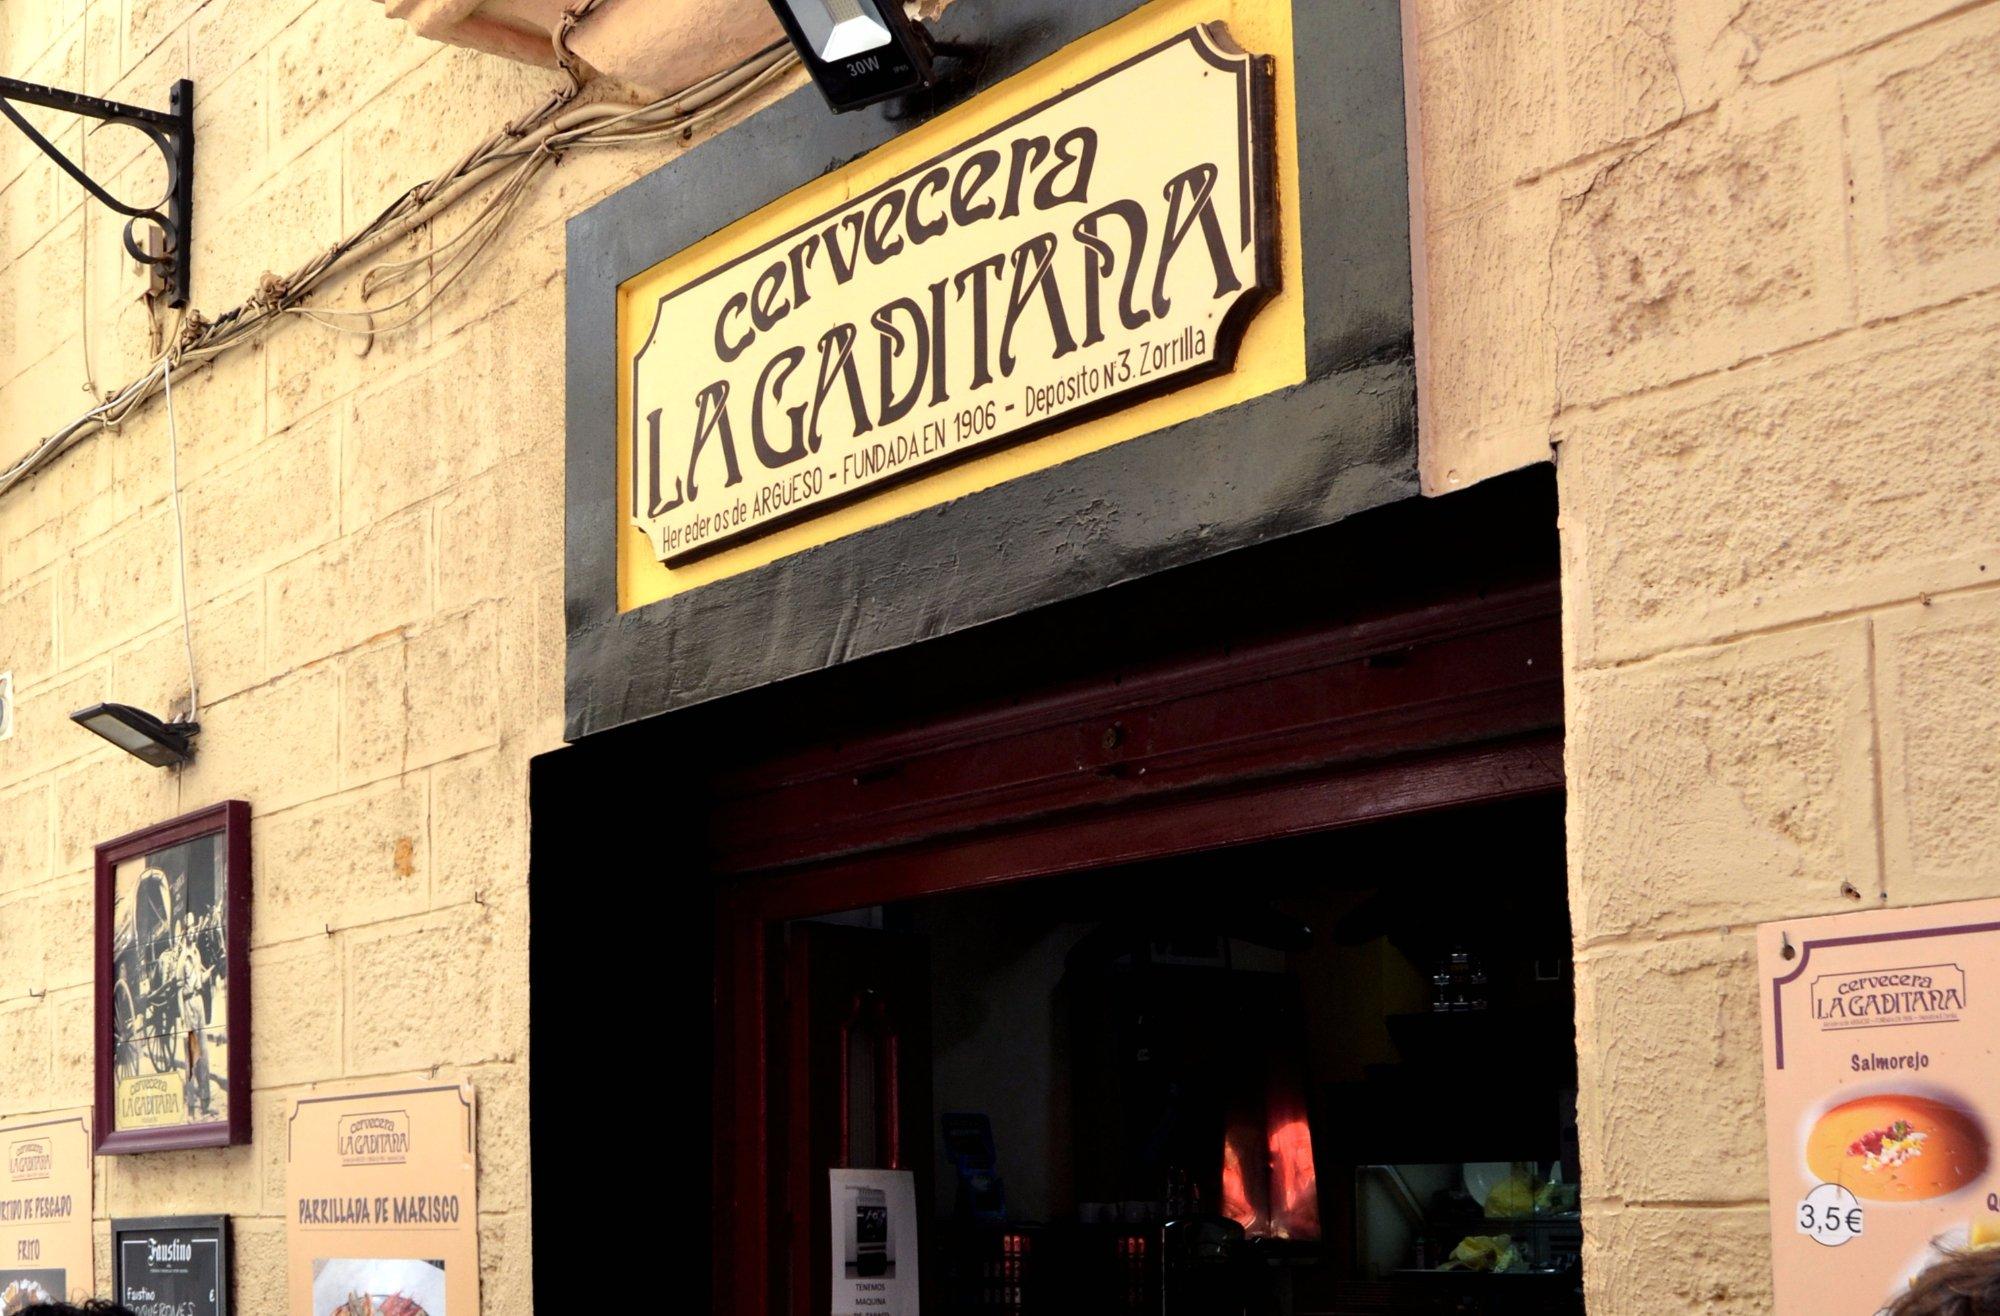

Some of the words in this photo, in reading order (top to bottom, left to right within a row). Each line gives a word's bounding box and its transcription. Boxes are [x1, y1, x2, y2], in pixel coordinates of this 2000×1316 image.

[847, 55, 880, 77] 30W
[713, 125, 1099, 363] cervecera
[646, 378, 742, 519] LA
[751, 162, 1243, 470] GADITANA
[752, 466, 823, 519] ARGÜESO
[843, 431, 919, 485] FUNDADA
[923, 418, 946, 455] EN
[953, 400, 997, 443] 1906
[1140, 325, 1206, 375] Zorrilla
[1838, 974, 1933, 996] cervecera
[1850, 1051, 1930, 1072] Salmorejo
[24, 1198, 33, 1219] DE
[34, 1194, 72, 1218] PESCADO
[299, 1197, 370, 1224] PARRILLADA
[374, 1197, 388, 1224] DE
[393, 1195, 459, 1224] MARISCO
[1800, 1203, 1863, 1234] 3,5€
[17, 1238, 40, 1261] FRITO
[148, 1238, 192, 1267] Faustino
